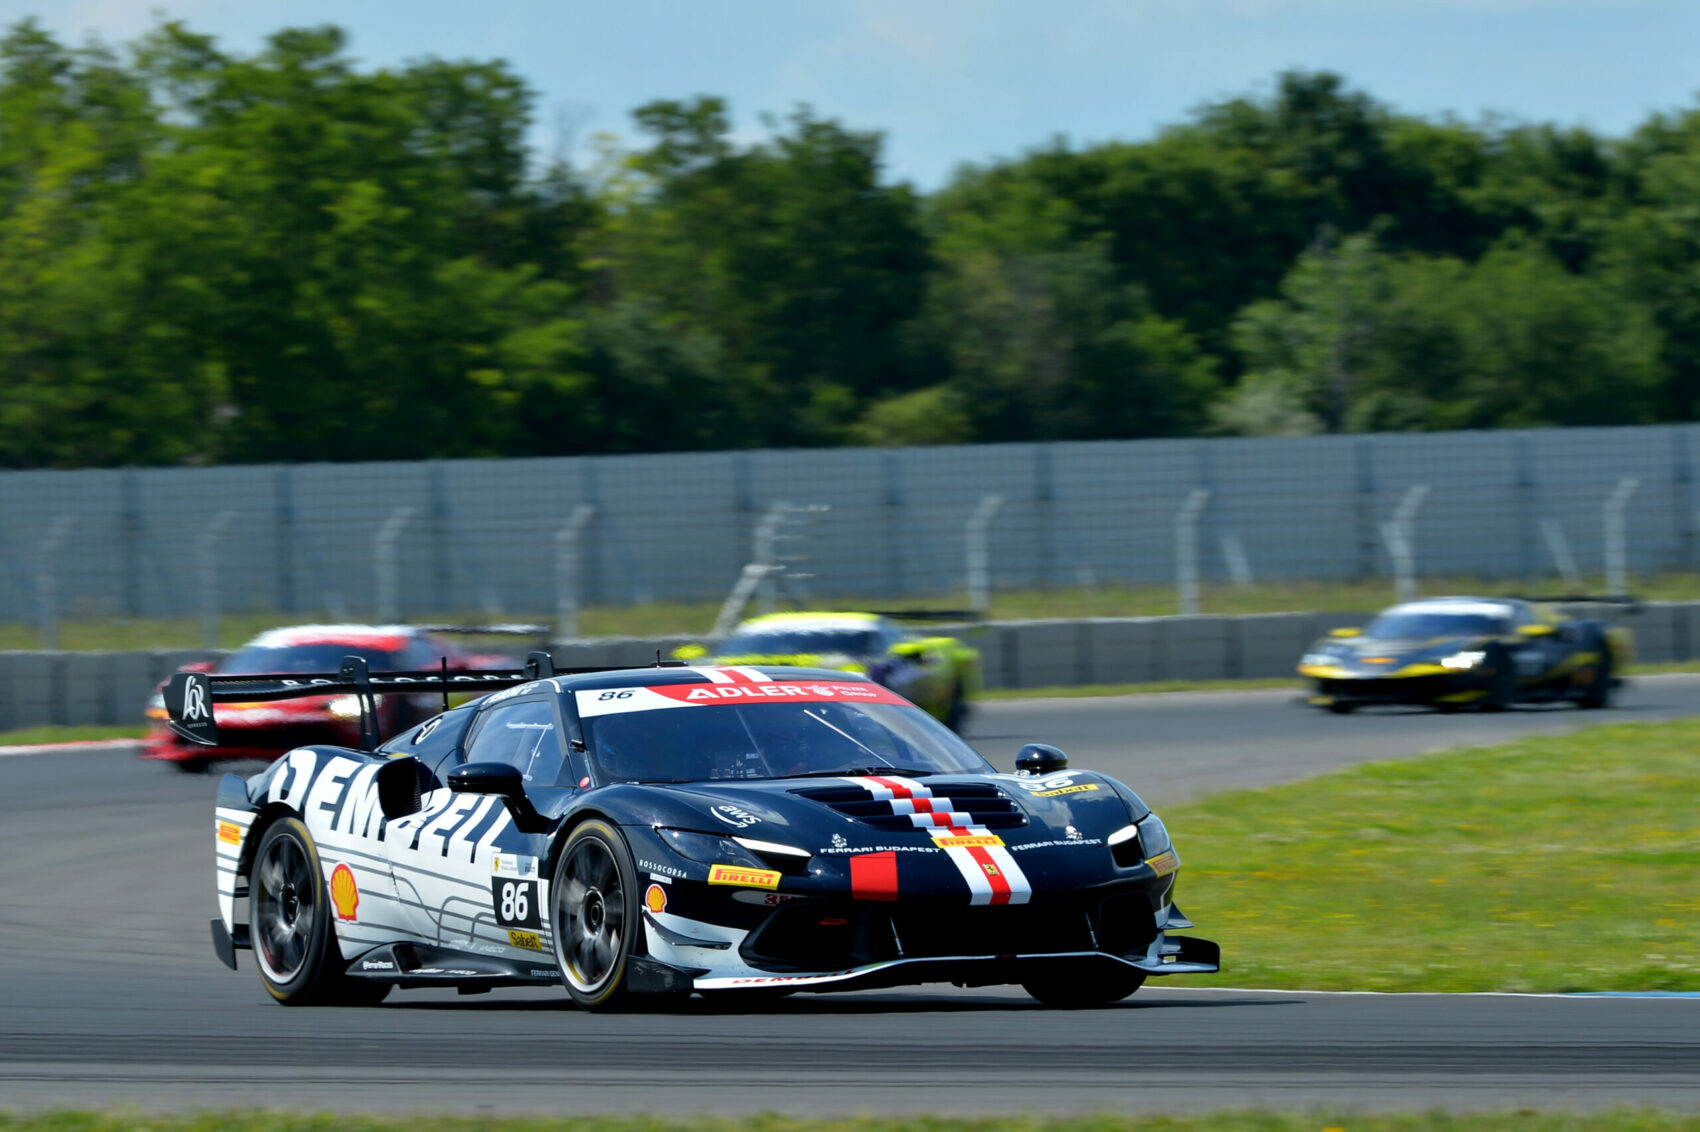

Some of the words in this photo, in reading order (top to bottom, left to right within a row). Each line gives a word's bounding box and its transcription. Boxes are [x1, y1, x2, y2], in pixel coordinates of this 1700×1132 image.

[598, 689, 635, 701] 86
[686, 685, 809, 700] ADLER
[718, 804, 762, 825] aws
[820, 846, 873, 854] FERRARI
[876, 846, 940, 854] BUDAPEST
[1011, 841, 1054, 851] FERRARI
[1054, 838, 1102, 846] BUDAPEST
[639, 859, 688, 878] ROSSOCORSA
[714, 868, 774, 885] PIRELLI
[501, 882, 529, 921] 86
